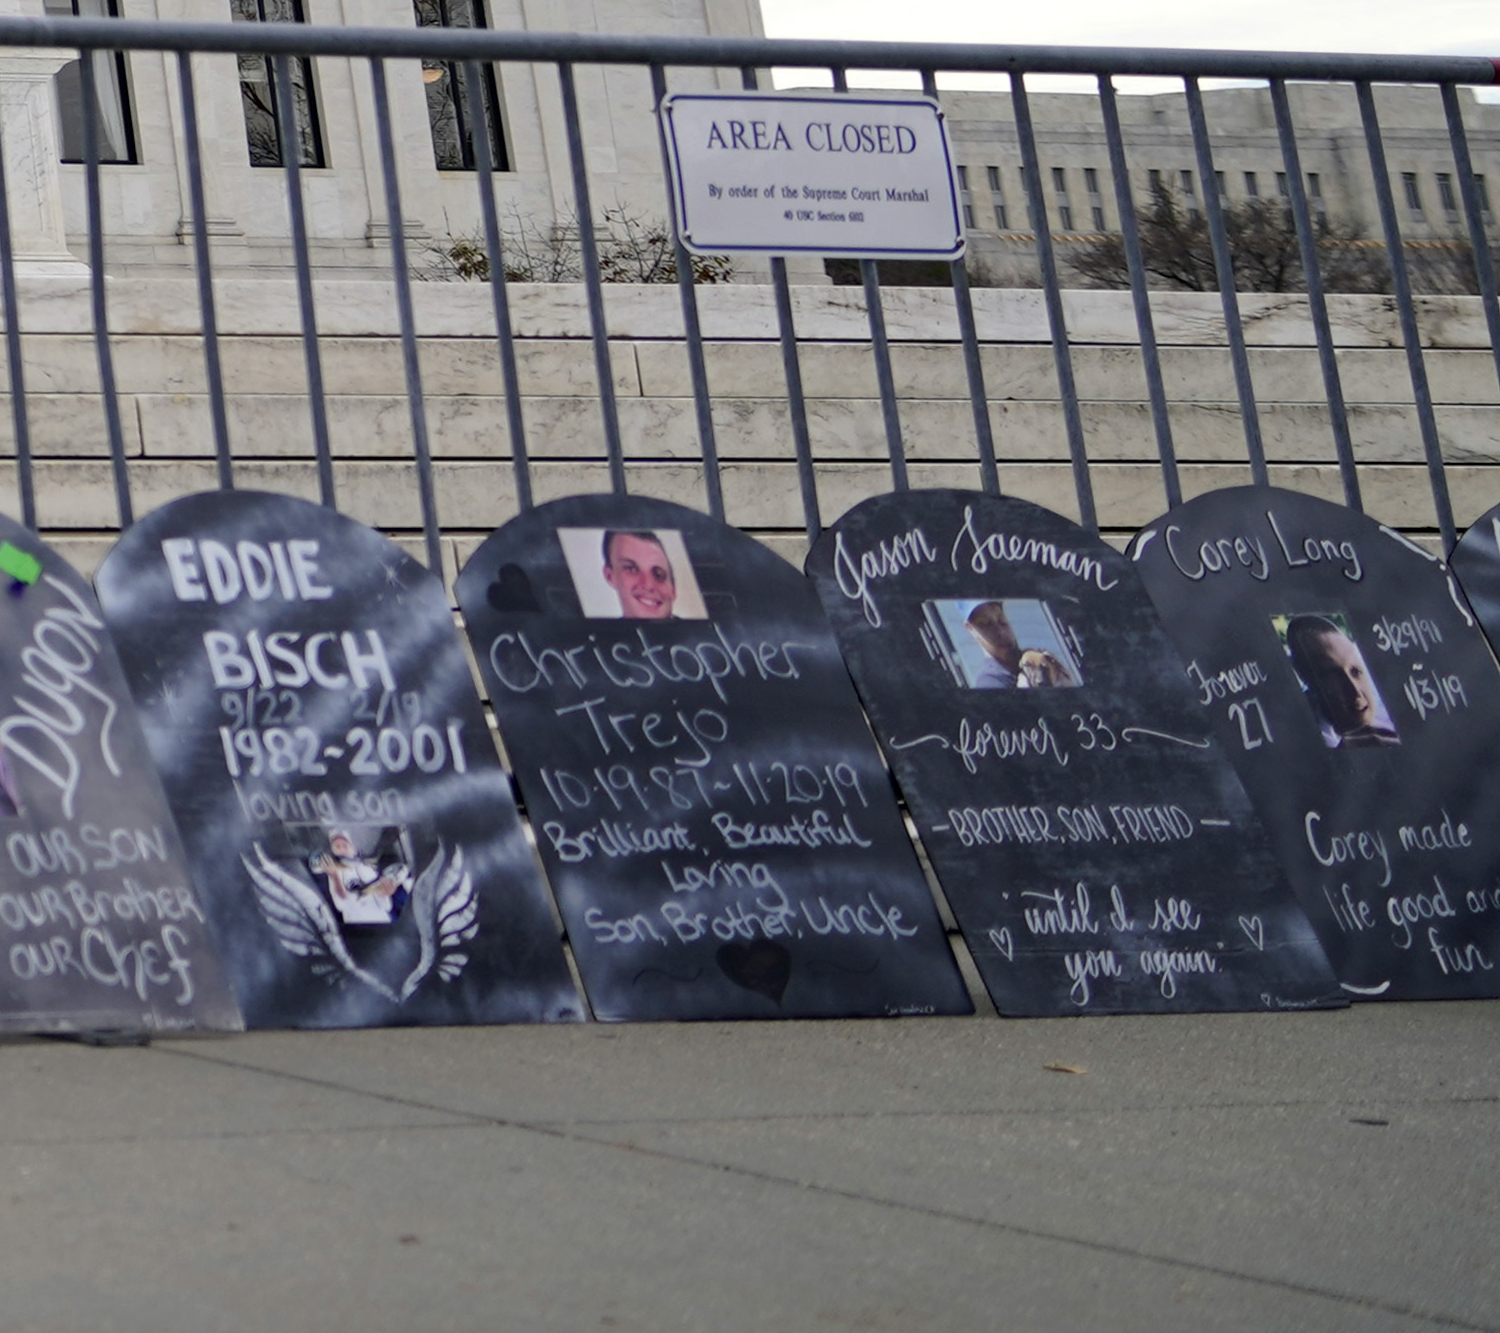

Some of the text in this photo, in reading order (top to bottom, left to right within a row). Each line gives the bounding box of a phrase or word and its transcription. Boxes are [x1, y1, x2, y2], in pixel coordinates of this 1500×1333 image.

[706, 120, 917, 154] AREA CLOSED
[708, 184, 930, 203] By order of the Supreme Court Marshal
[161, 538, 334, 605] EDDIE
[1164, 510, 1362, 582] Corey Long
[833, 526, 938, 629] Jason
[203, 629, 397, 693] BISCH
[489, 622, 818, 704] Christopher
[1186, 658, 1268, 706] Forever
[221, 689, 423, 730] 9/22 2/19
[555, 697, 730, 768] Trejo
[1228, 696, 1274, 751] 27
[953, 713, 1117, 774] forever 33
[233, 779, 401, 832] loving son
[710, 809, 871, 853] Beautiful
[1304, 808, 1472, 888] Corey made
[661, 861, 789, 910] Loving
[1322, 875, 1456, 949] life good
[800, 893, 918, 942] Uncle
[1148, 896, 1202, 934] see
[1063, 944, 1123, 1006] you
